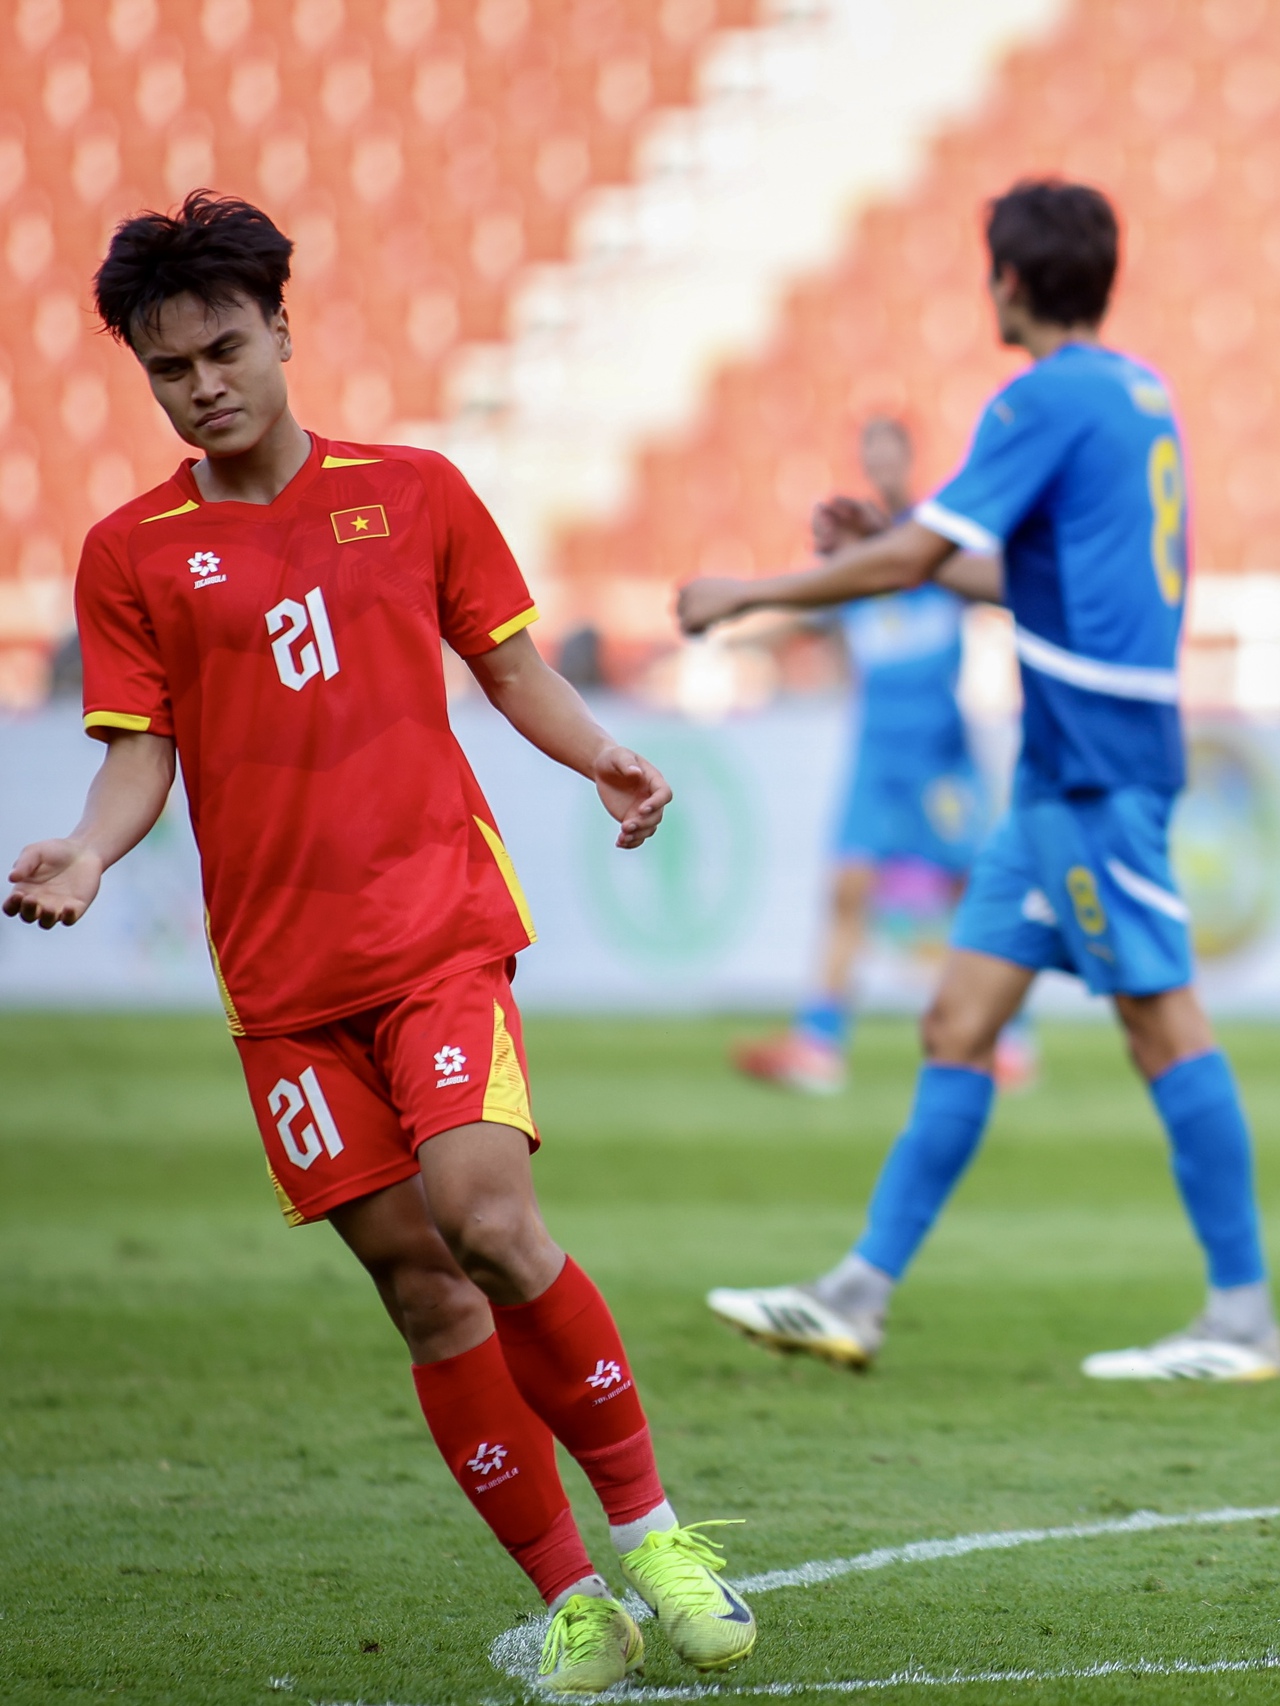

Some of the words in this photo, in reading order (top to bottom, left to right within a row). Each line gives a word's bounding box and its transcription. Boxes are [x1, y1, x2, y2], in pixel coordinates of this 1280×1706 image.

[265, 586, 340, 692] 21
[1065, 864, 1107, 936] 8
[267, 1065, 345, 1171] 21
